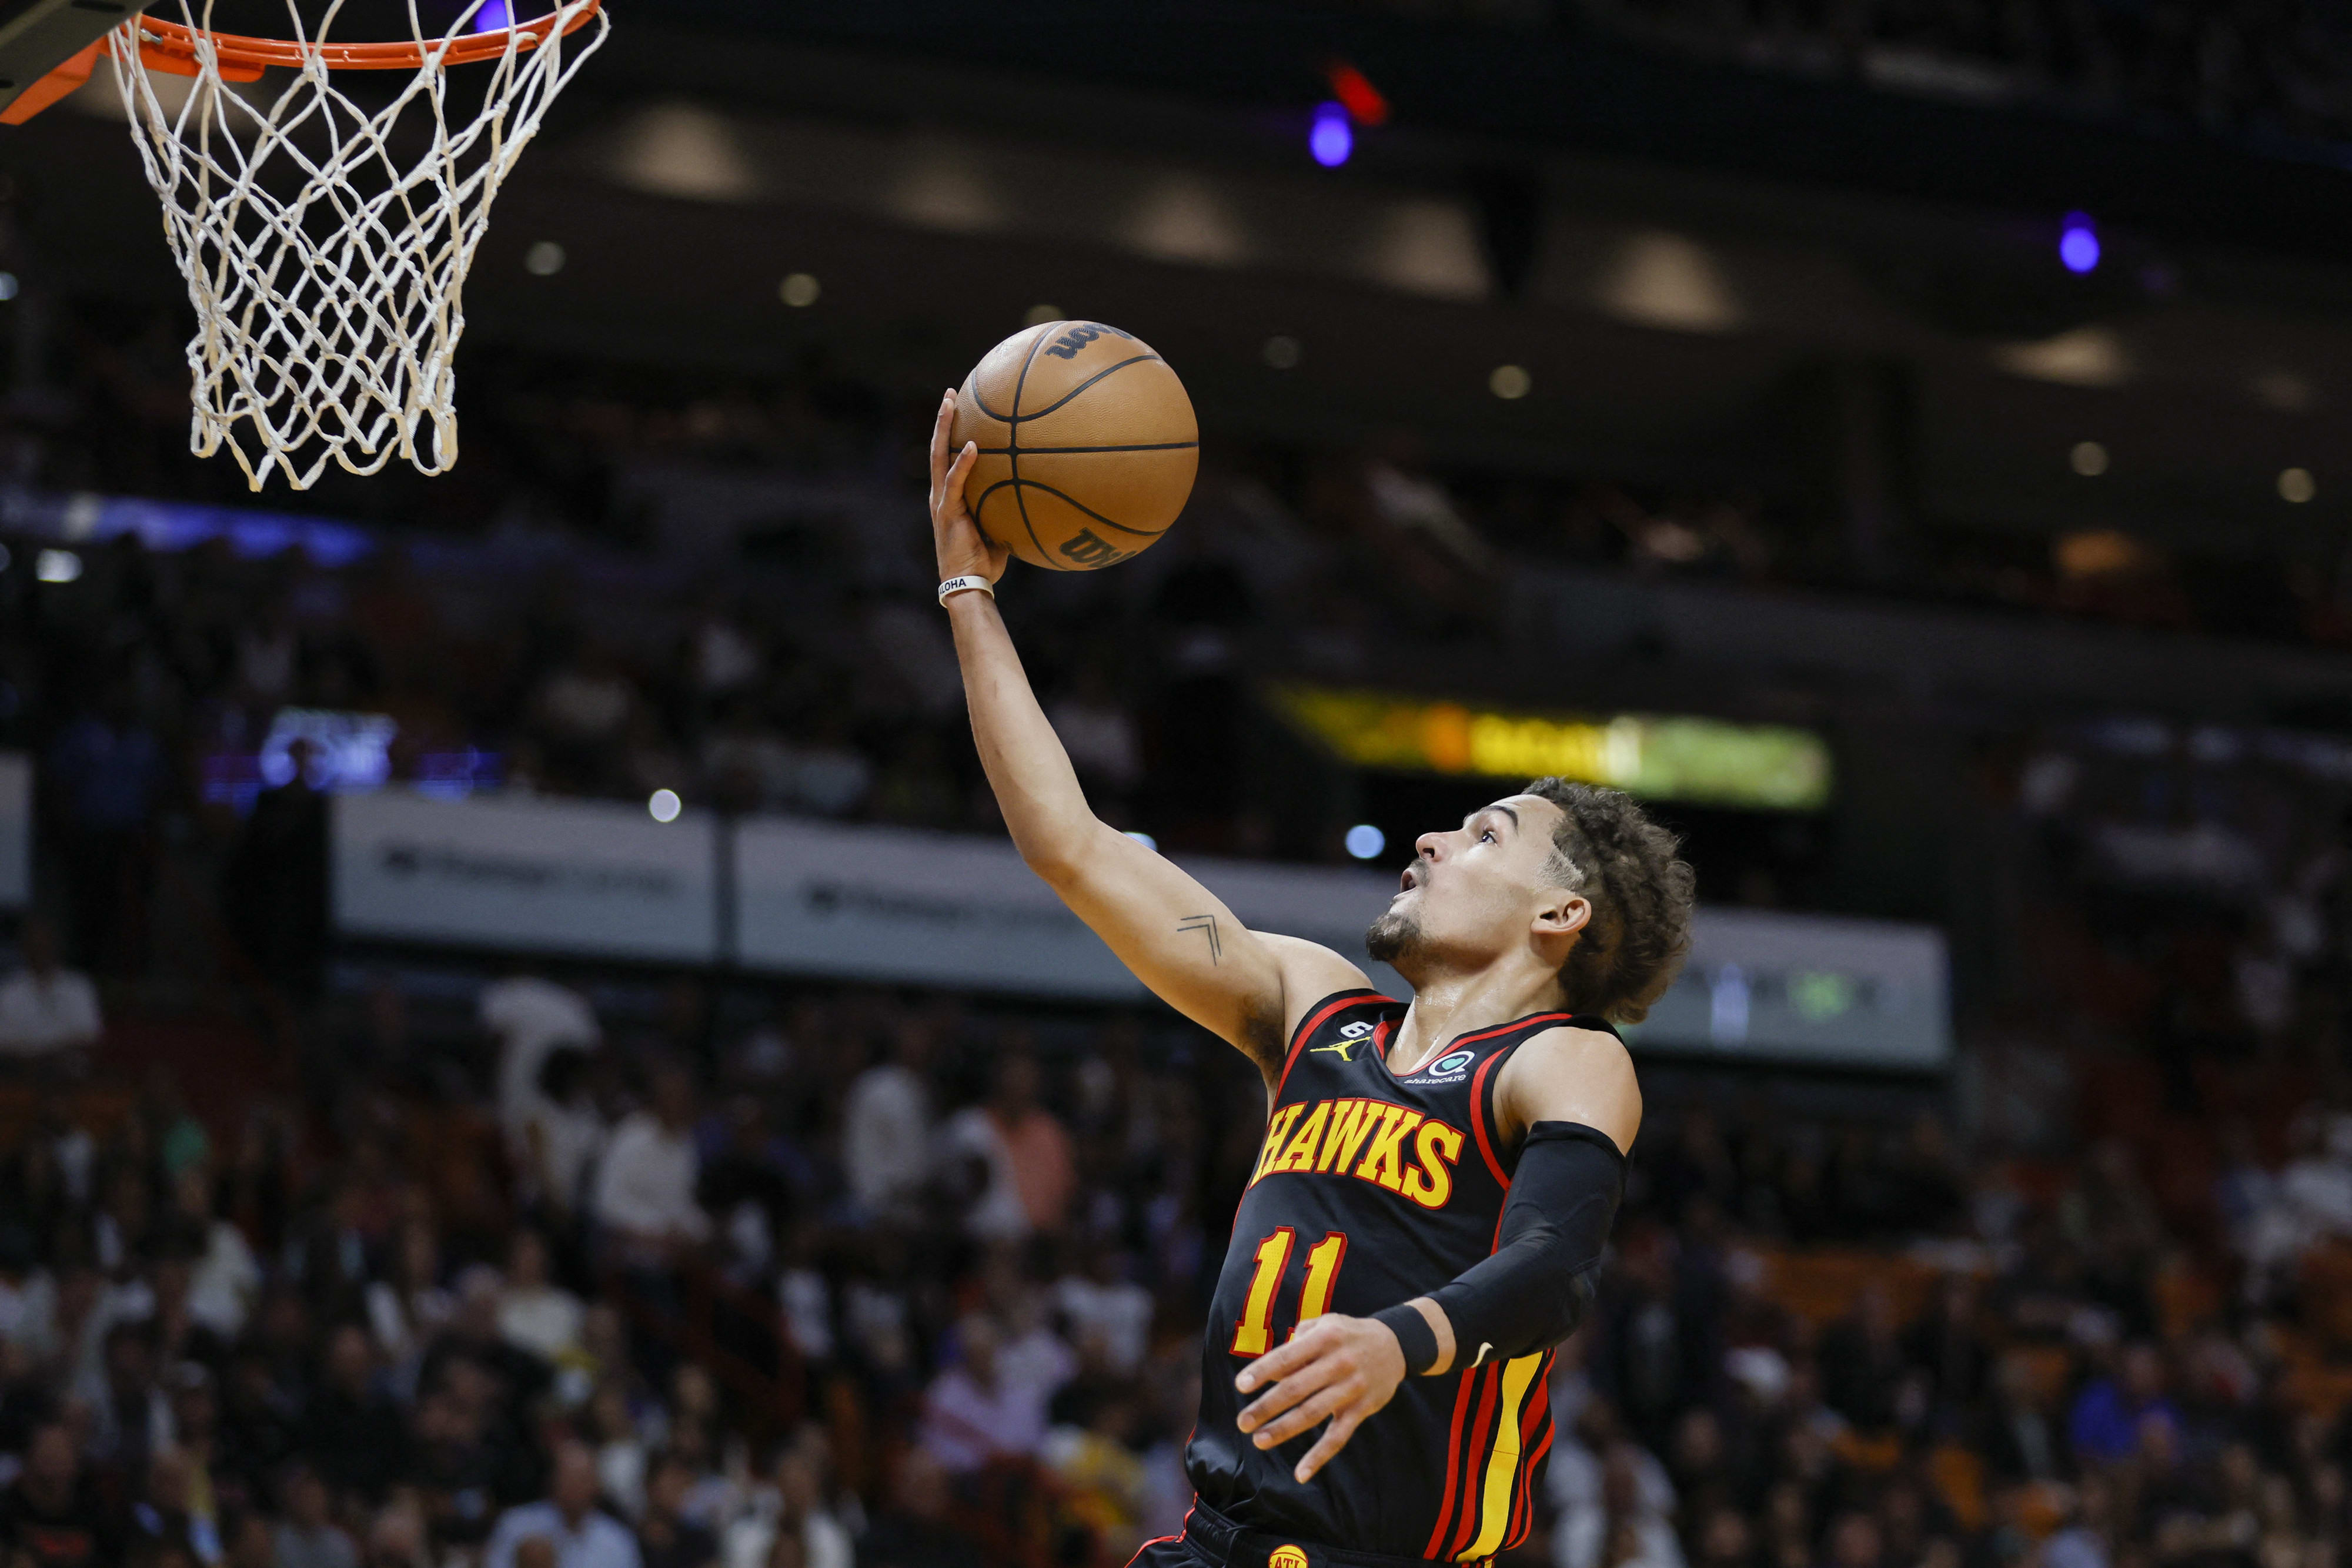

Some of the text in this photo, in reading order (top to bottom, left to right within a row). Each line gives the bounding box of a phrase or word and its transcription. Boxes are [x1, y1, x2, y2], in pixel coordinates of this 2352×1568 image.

[1340, 1021, 1374, 1038] 6
[1404, 1074, 1466, 1084] sharecare
[1249, 1098, 1466, 1209] HAWKS
[1230, 1226, 1347, 1359] 11
